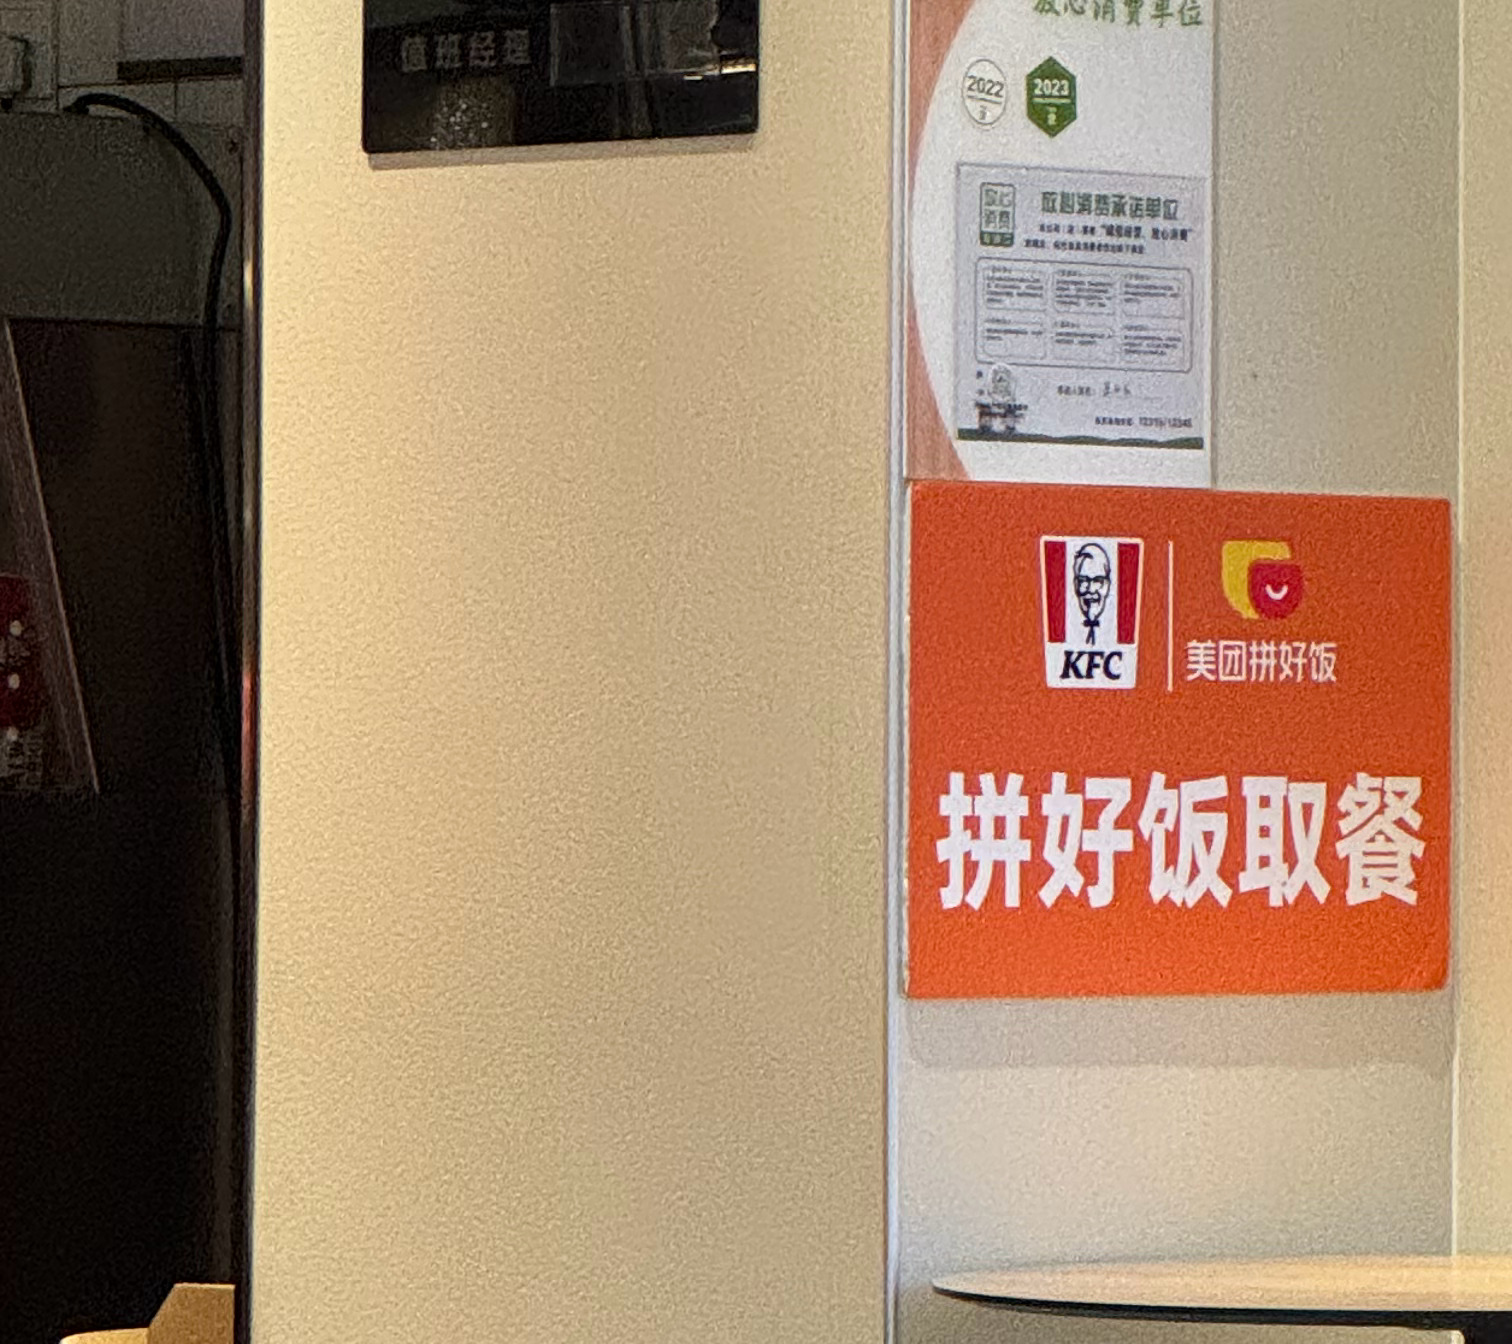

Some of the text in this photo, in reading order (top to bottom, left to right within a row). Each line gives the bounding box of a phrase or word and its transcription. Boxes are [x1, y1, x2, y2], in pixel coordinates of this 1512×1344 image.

[966, 74, 1004, 98] 2022
[1033, 78, 1070, 96] 2023
[1060, 650, 1123, 681] KFC
[1186, 640, 1338, 683] 美团拼好饭
[936, 771, 1425, 911] 拼好饭取餐
